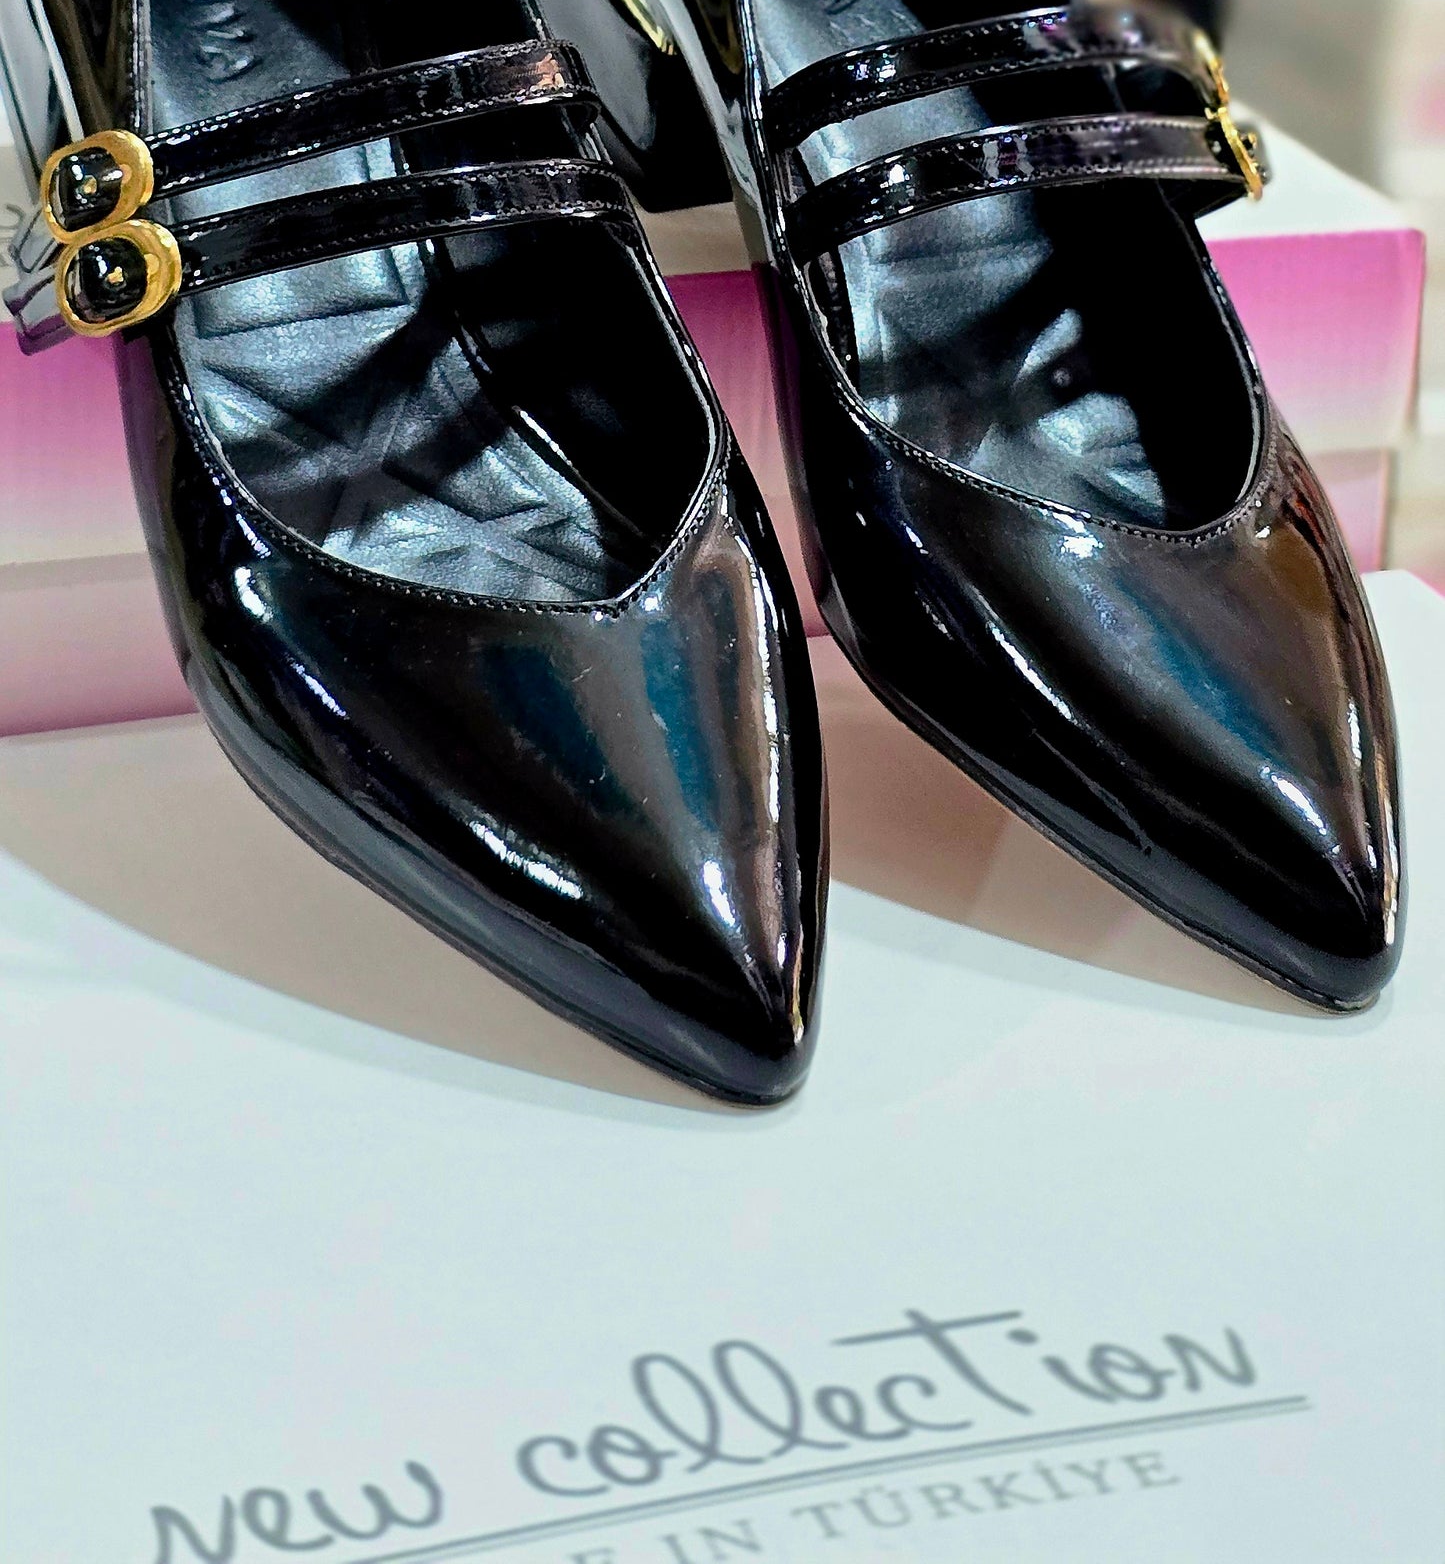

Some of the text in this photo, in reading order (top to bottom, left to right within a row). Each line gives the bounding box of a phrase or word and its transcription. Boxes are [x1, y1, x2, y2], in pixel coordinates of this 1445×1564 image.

[516, 1310, 1257, 1498] collection
[660, 1450, 1182, 1564] IN TÜRKİYE
